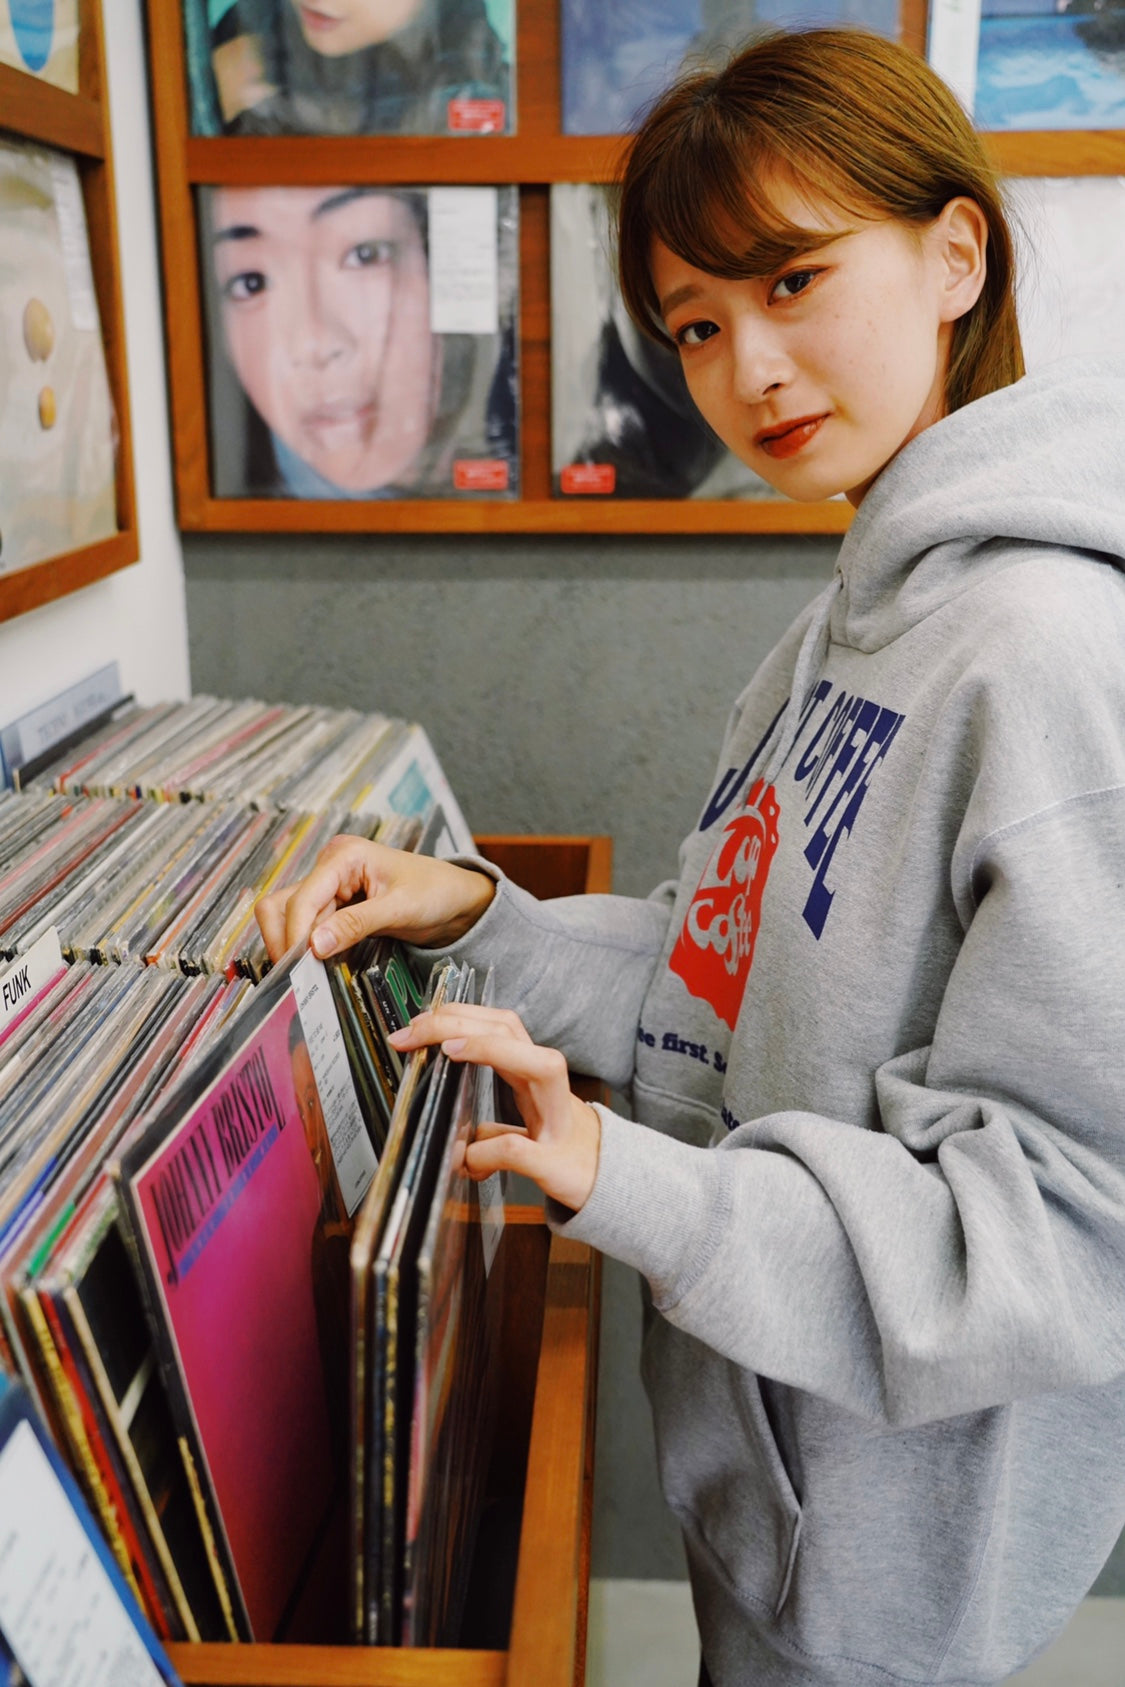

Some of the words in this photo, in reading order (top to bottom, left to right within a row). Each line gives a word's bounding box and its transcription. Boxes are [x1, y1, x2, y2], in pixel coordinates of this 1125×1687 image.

[794, 690, 906, 941] COFFEE
[2, 964, 32, 1012] FUNK
[662, 1032, 709, 1064] first.
[211, 1045, 287, 1179] BRISTOL
